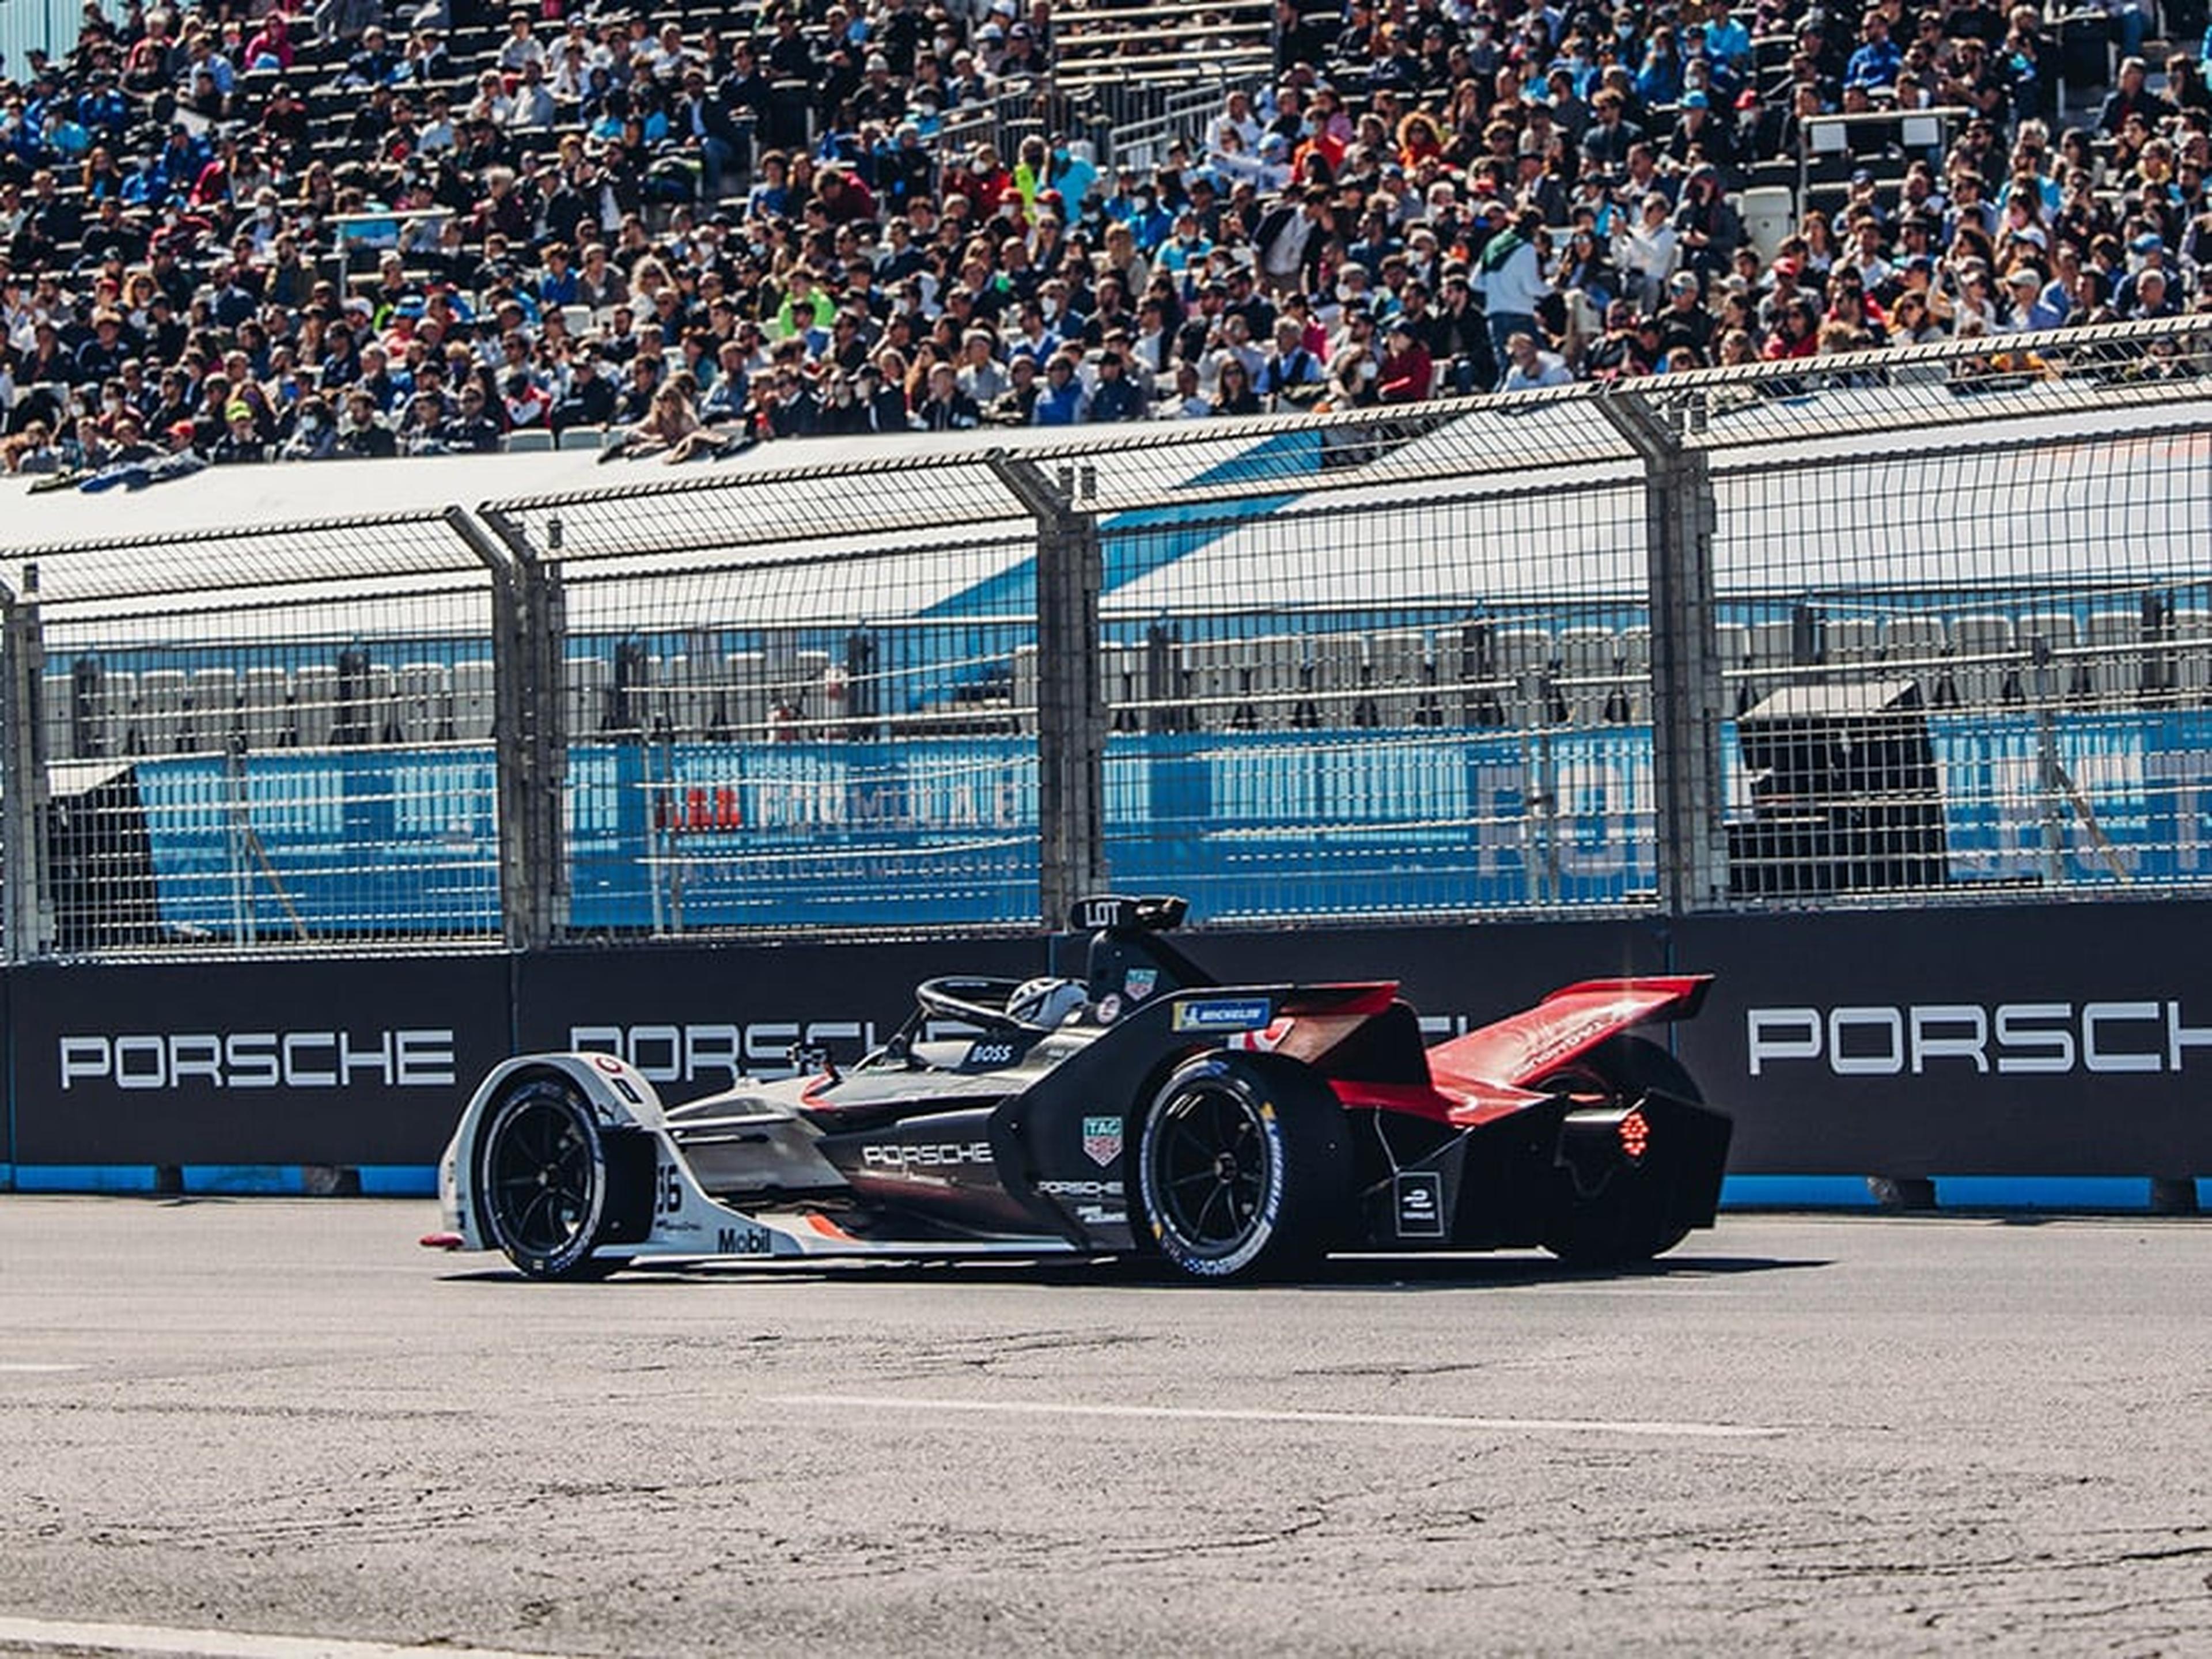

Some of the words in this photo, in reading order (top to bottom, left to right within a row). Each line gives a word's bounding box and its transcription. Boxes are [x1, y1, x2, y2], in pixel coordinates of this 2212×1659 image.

[1085, 901, 1121, 927] LOT
[59, 1030, 456, 1089] PORSCHE
[971, 1045, 1013, 1062] BOSS
[1087, 1121, 1121, 1135] TAG
[862, 1142, 994, 1166] PORSCHE
[1038, 1181, 1124, 1194] PORSCHE
[718, 1227, 771, 1254] Mobil
